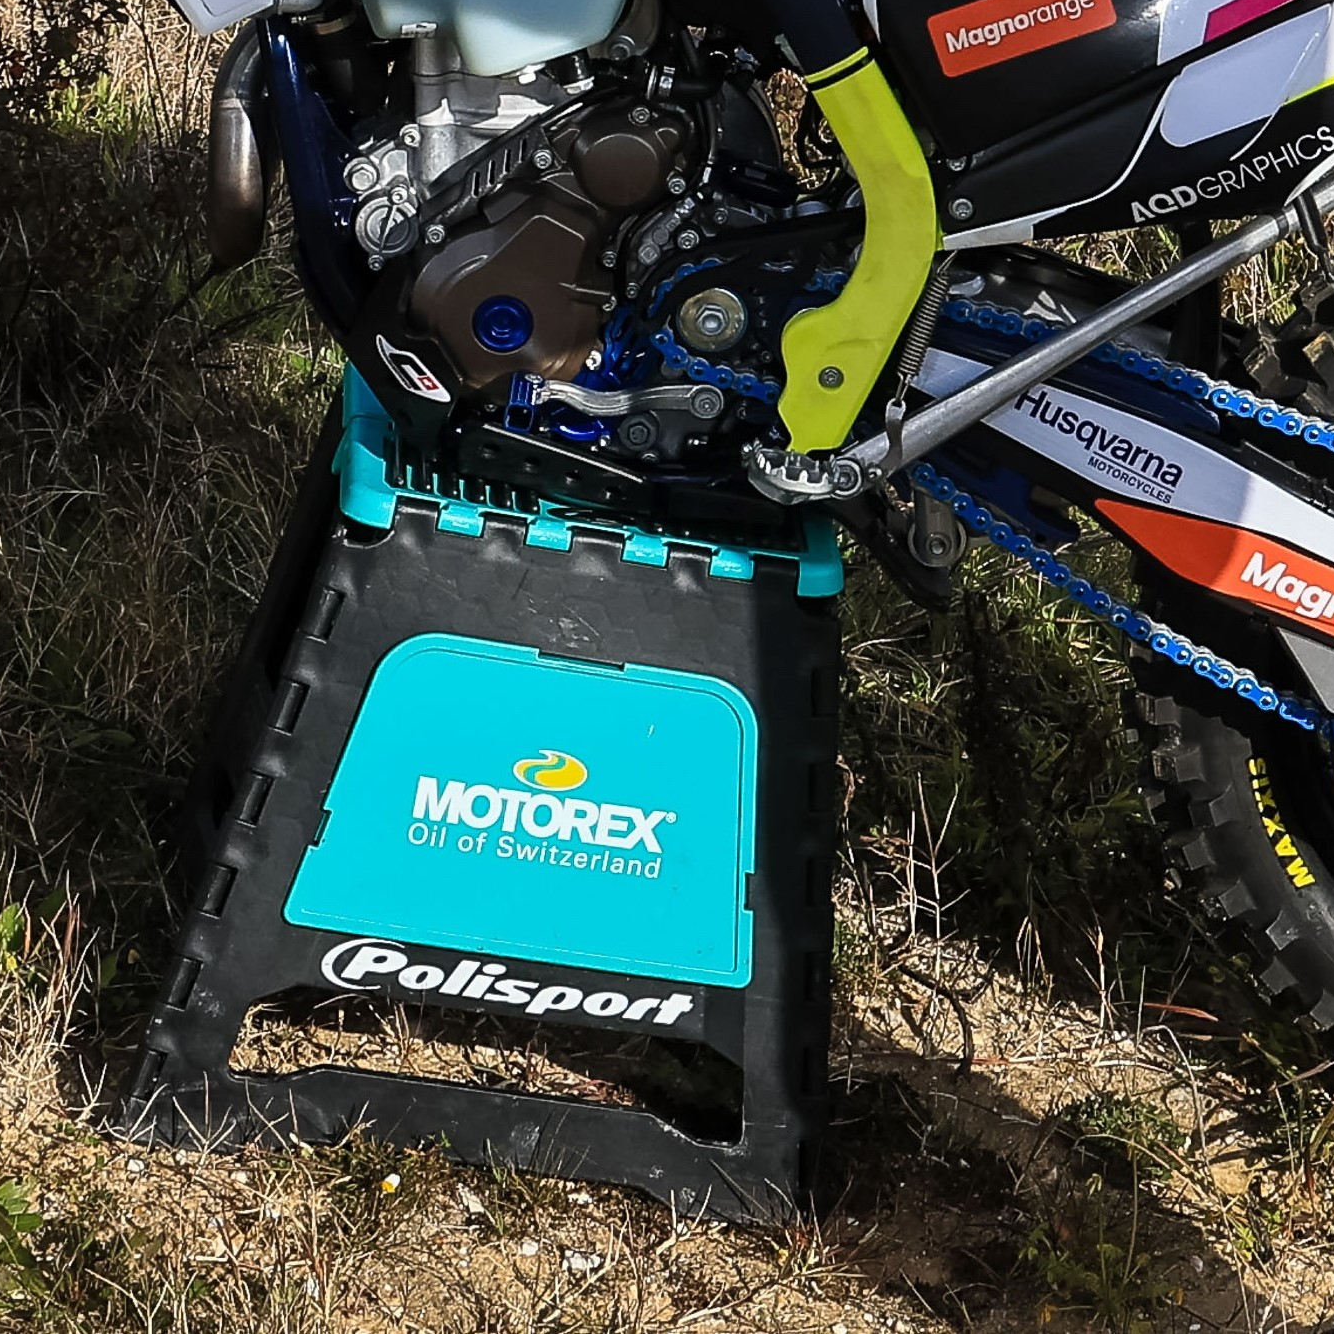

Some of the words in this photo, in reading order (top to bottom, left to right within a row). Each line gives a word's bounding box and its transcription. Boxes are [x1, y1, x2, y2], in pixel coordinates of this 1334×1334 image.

[1014, 390, 1184, 489] Husqvarna
[1087, 455, 1173, 504] MOTORCYCLES
[407, 821, 448, 849] Oil
[457, 832, 489, 855] of
[495, 834, 663, 880] Switzerland
[412, 775, 669, 854] MOTOREX
[1247, 756, 1317, 888] MAXXIS
[342, 942, 695, 1026] Polisport
